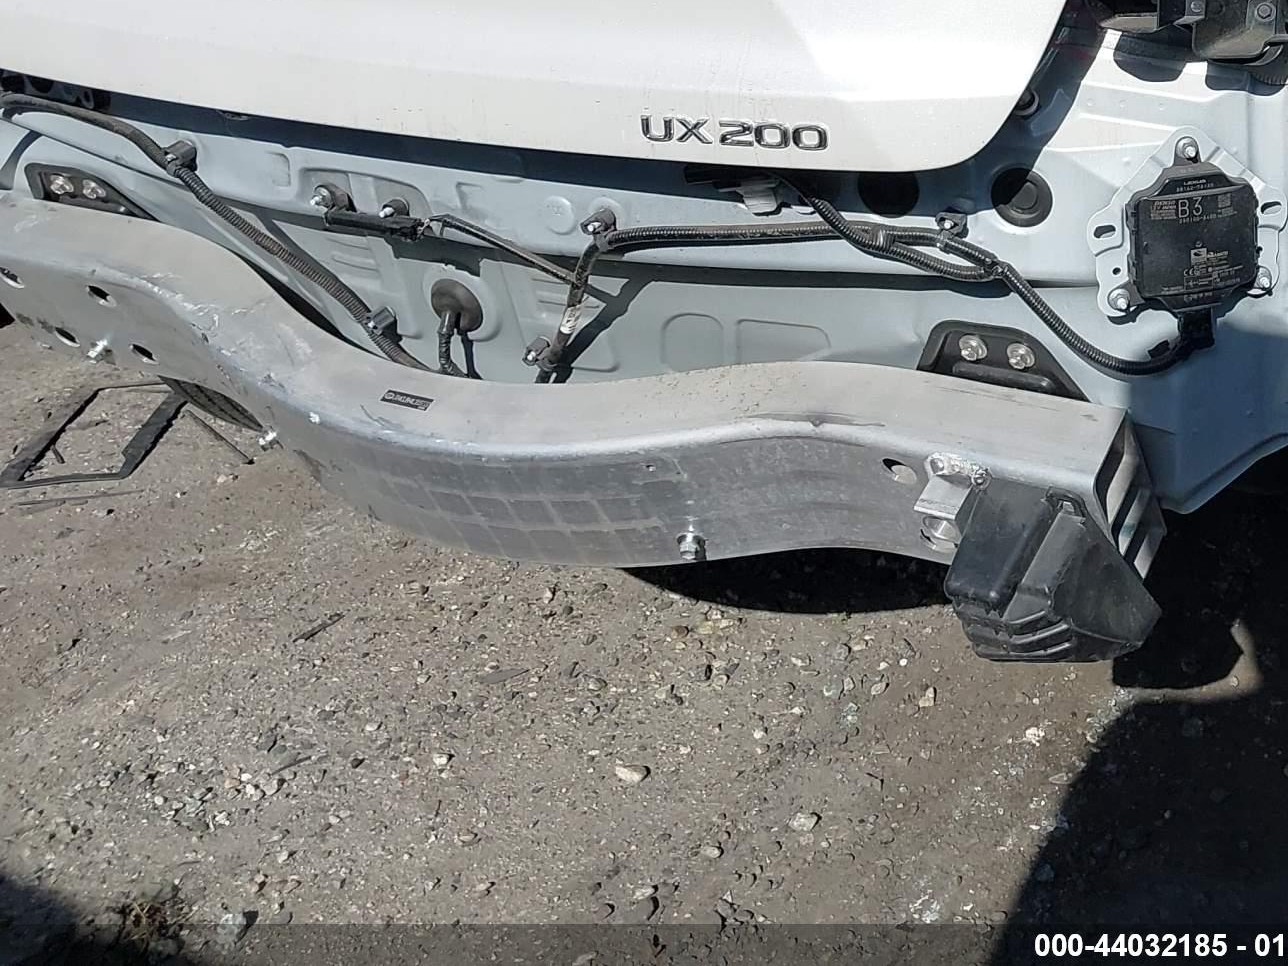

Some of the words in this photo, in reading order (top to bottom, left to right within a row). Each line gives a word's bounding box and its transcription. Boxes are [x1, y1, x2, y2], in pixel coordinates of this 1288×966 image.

[640, 114, 713, 144] UX
[718, 120, 828, 151] 200
[1178, 196, 1203, 219] B3
